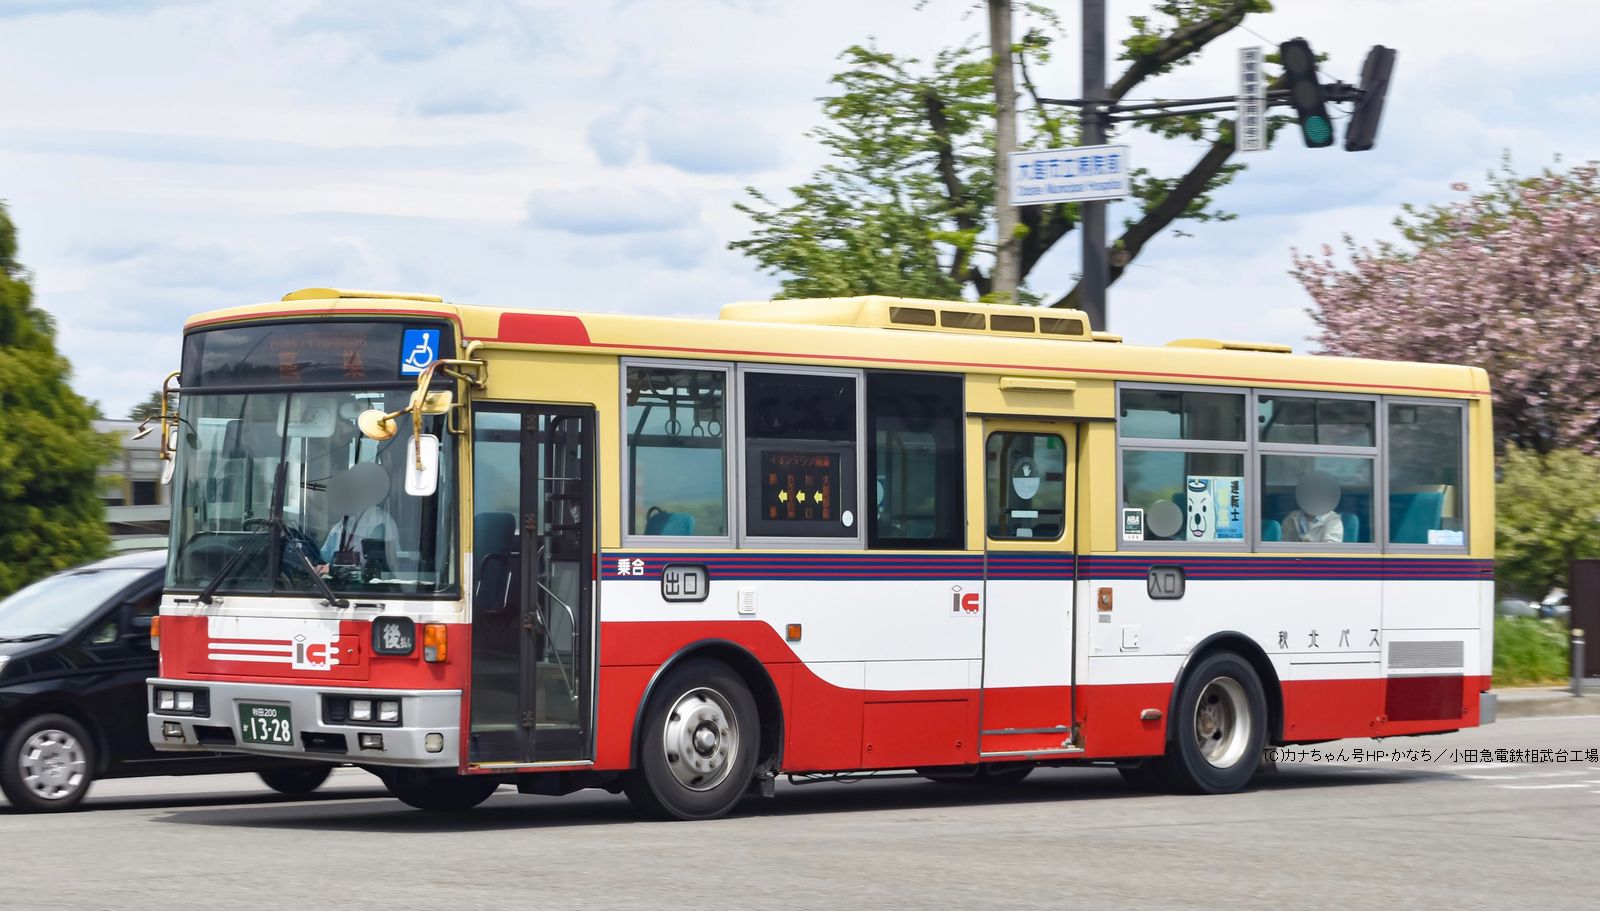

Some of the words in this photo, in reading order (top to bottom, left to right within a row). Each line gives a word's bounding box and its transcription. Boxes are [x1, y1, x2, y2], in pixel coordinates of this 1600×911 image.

[617, 558, 645, 576] 乗合
[665, 572, 698, 596] 出口
[1150, 572, 1176, 594] 入口
[1279, 629, 1380, 649] 秋北バス
